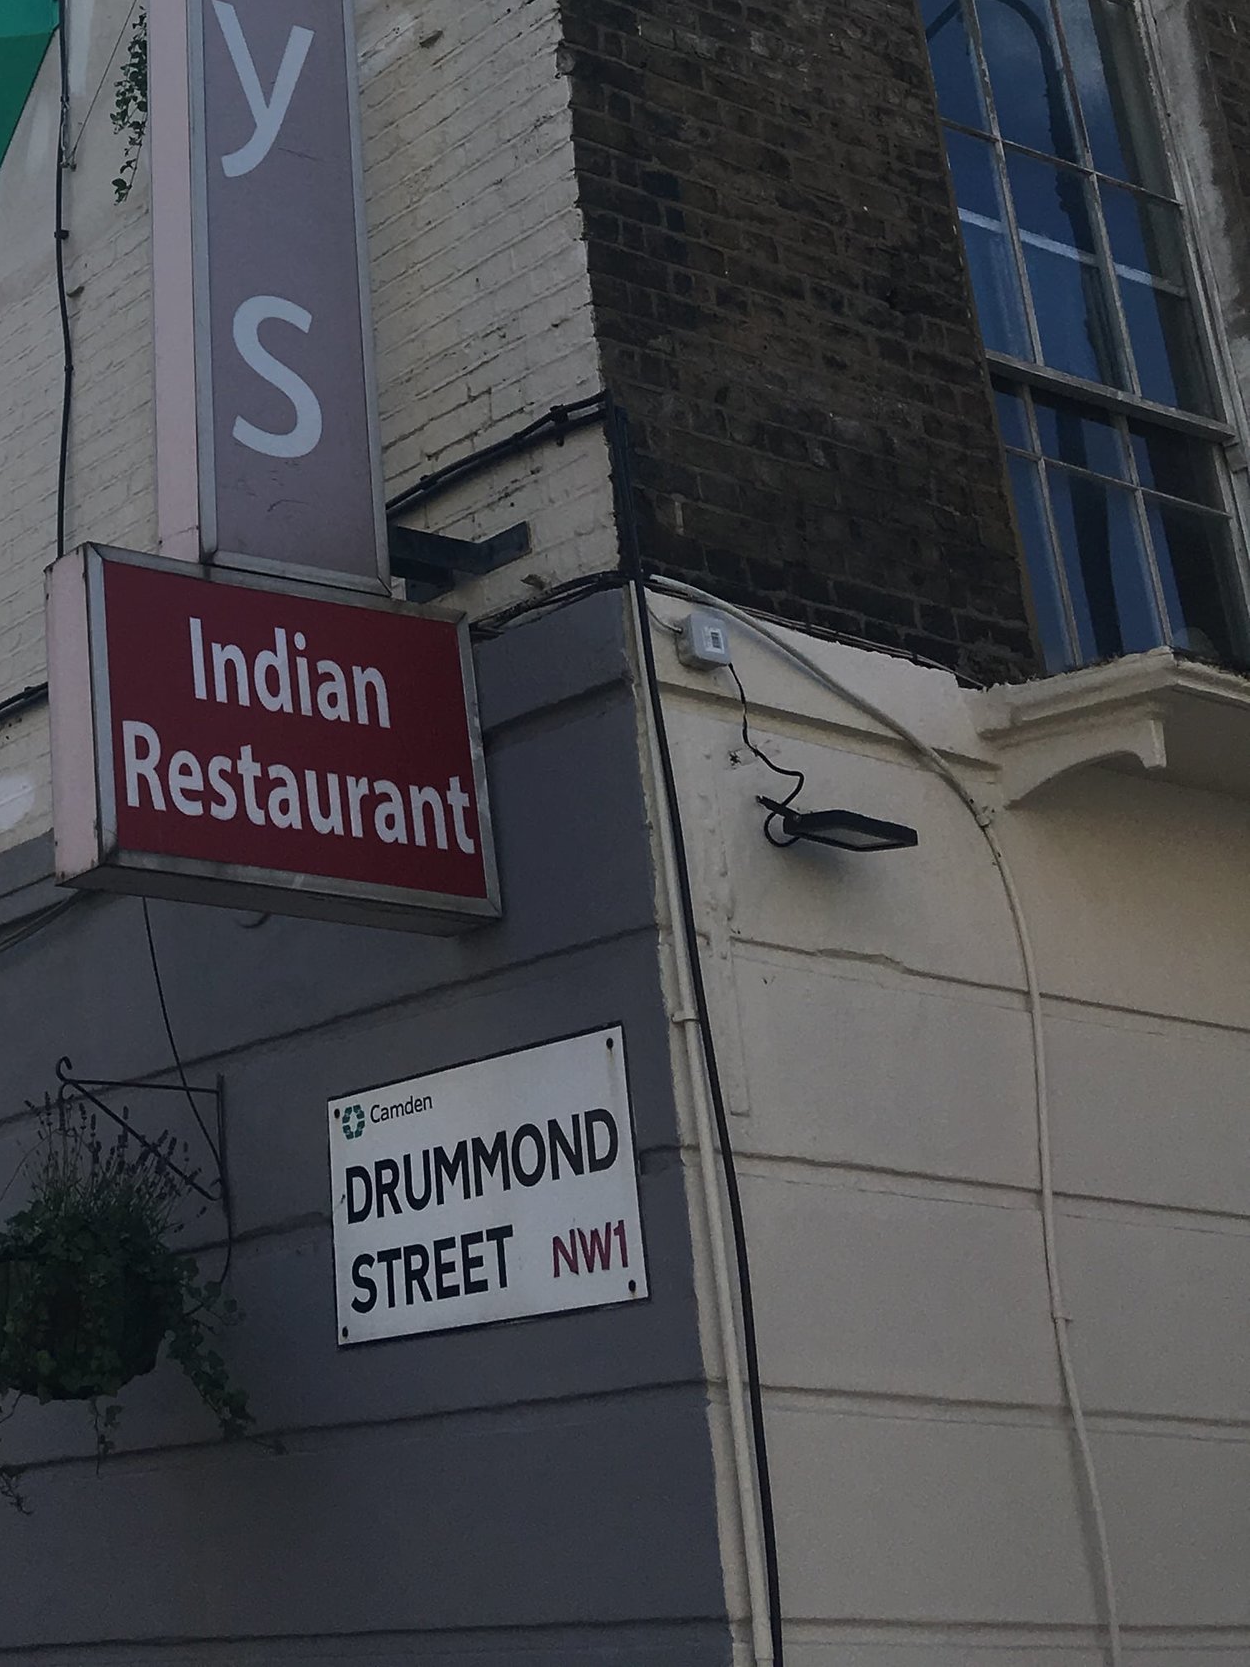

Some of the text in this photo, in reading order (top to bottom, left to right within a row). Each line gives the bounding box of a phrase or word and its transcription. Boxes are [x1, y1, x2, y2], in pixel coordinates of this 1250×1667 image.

[189, 616, 391, 729] Indian
[121, 719, 476, 855] Restaurant
[370, 1095, 433, 1124] Camden
[345, 1108, 619, 1225] DRUMMOND
[351, 1219, 629, 1314] STREET NW1
